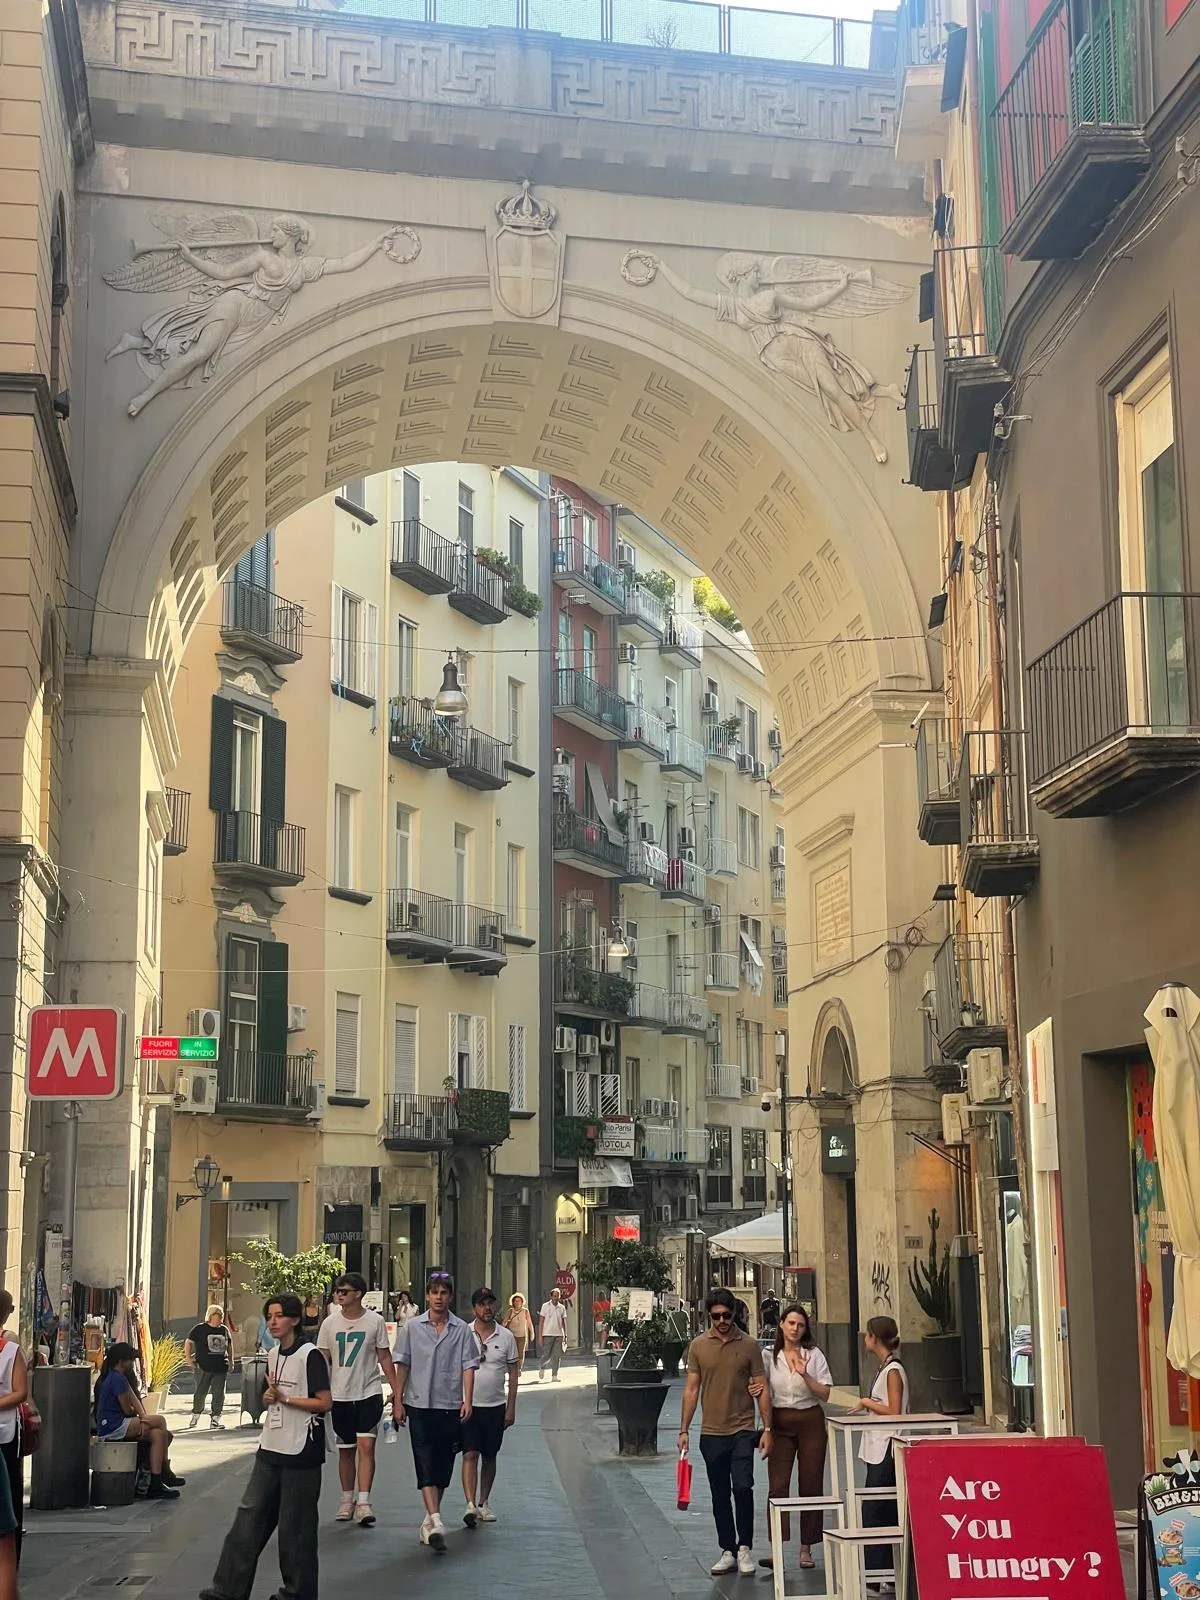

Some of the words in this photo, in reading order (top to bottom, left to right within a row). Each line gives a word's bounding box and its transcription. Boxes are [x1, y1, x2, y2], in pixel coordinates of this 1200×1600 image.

[36, 1027, 108, 1078] M
[180, 1049, 215, 1057] SERVIZIO
[556, 1276, 574, 1285] ALDI
[335, 1331, 366, 1368] 17
[939, 1475, 1001, 1500] Are
[941, 1514, 1012, 1539] You
[947, 1552, 1076, 1581] Hungry
[1083, 1551, 1102, 1577] ?
